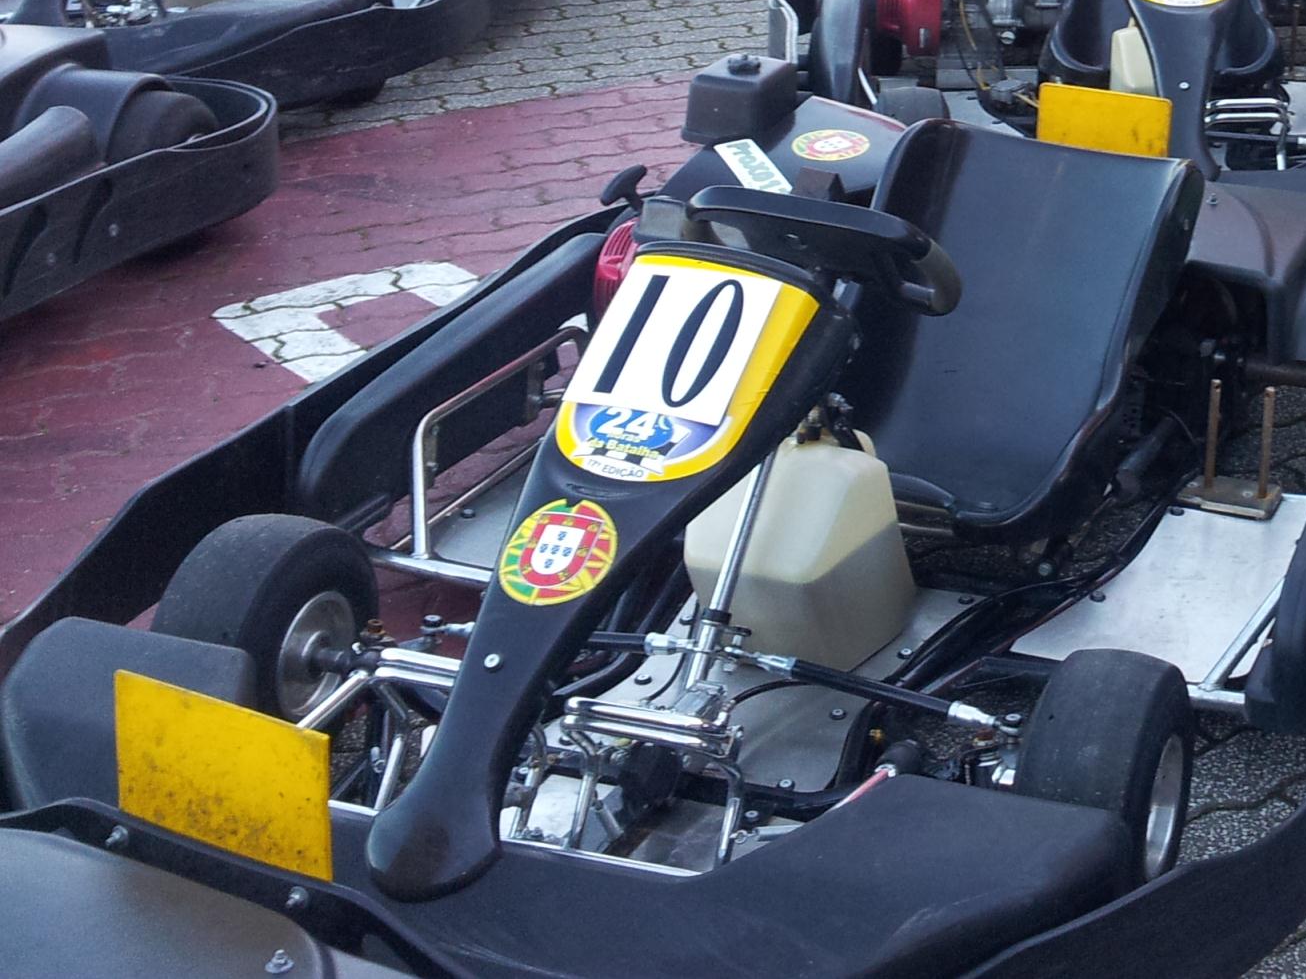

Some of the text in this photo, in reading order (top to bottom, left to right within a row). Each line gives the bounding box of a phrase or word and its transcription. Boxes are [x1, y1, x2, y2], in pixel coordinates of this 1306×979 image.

[592, 274, 745, 409] 10
[595, 405, 658, 441] 24
[606, 439, 660, 459] Batalha
[602, 463, 645, 478] EDIÇÃO
